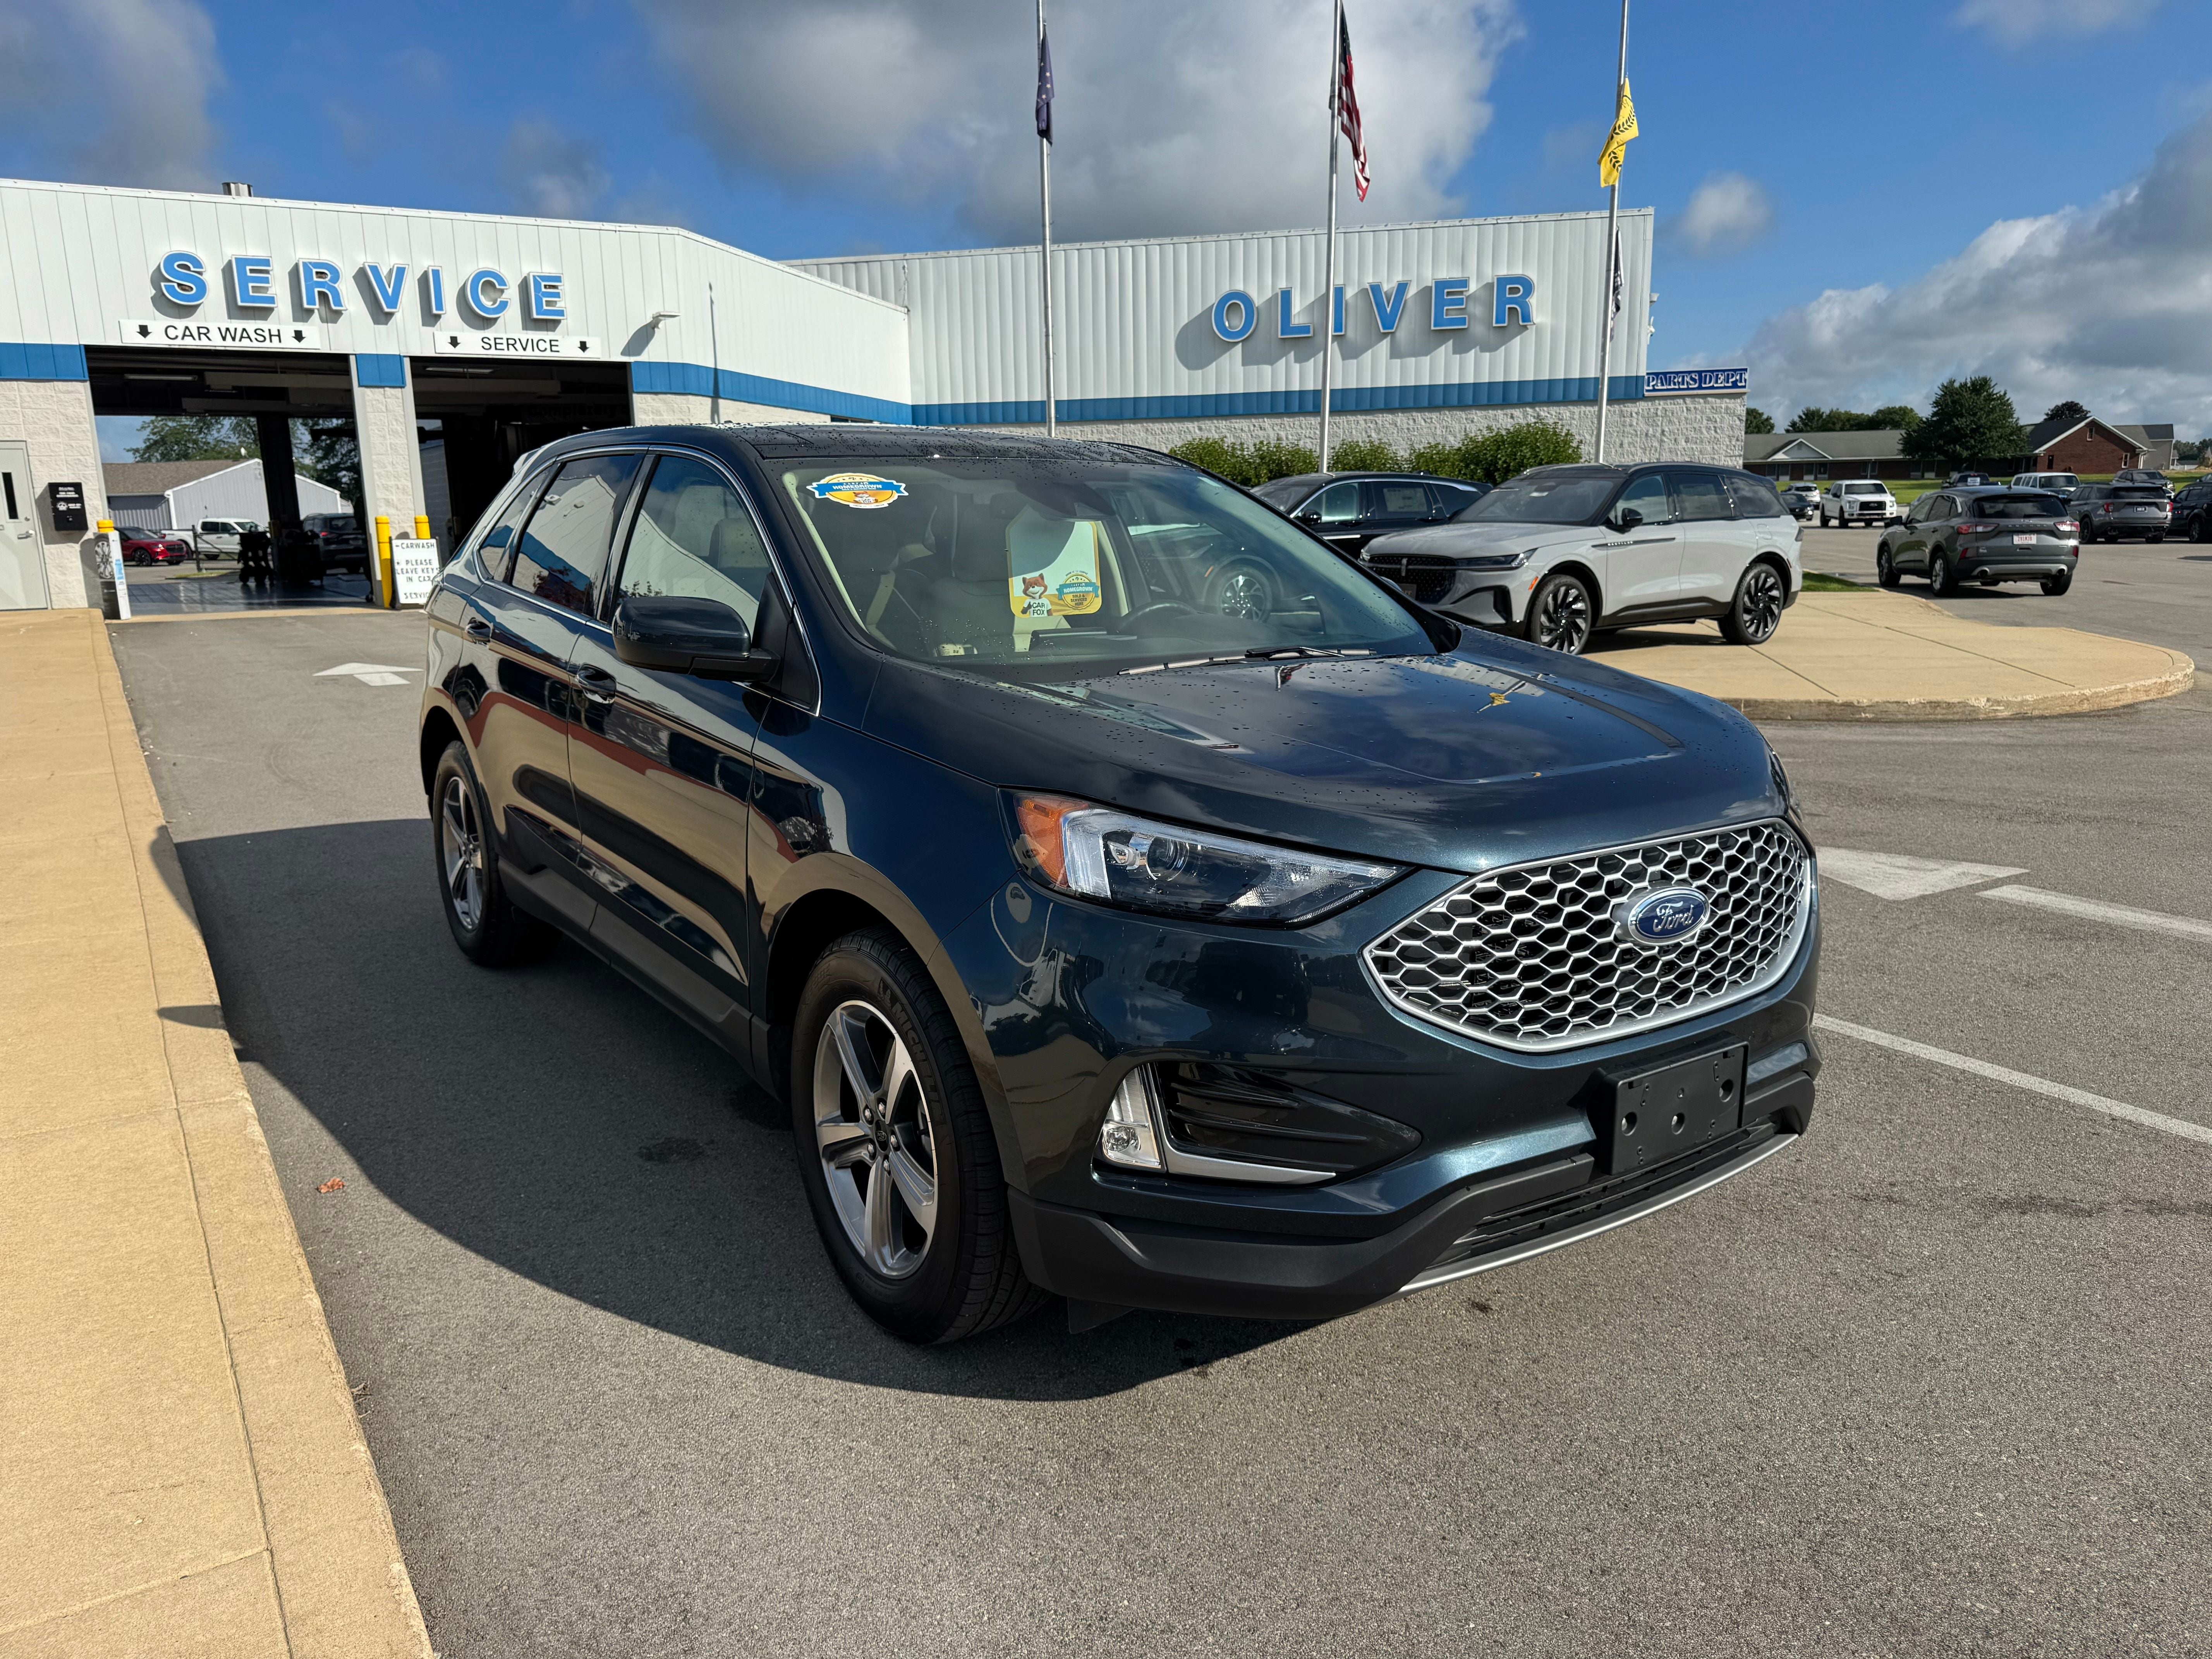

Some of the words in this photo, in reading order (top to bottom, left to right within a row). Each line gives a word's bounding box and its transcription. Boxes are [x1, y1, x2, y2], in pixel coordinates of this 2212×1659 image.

[160, 251, 567, 320] SERVICE
[1211, 274, 1535, 342] OLIVER
[164, 325, 212, 341] CAR
[217, 327, 282, 343] WASH
[481, 337, 560, 353] SERVICE
[1645, 373, 1698, 390] PARTS
[1702, 371, 1747, 387] DEPT
[1653, 901, 1694, 932] Ford
[891, 1002, 946, 1125] MICHELIN
